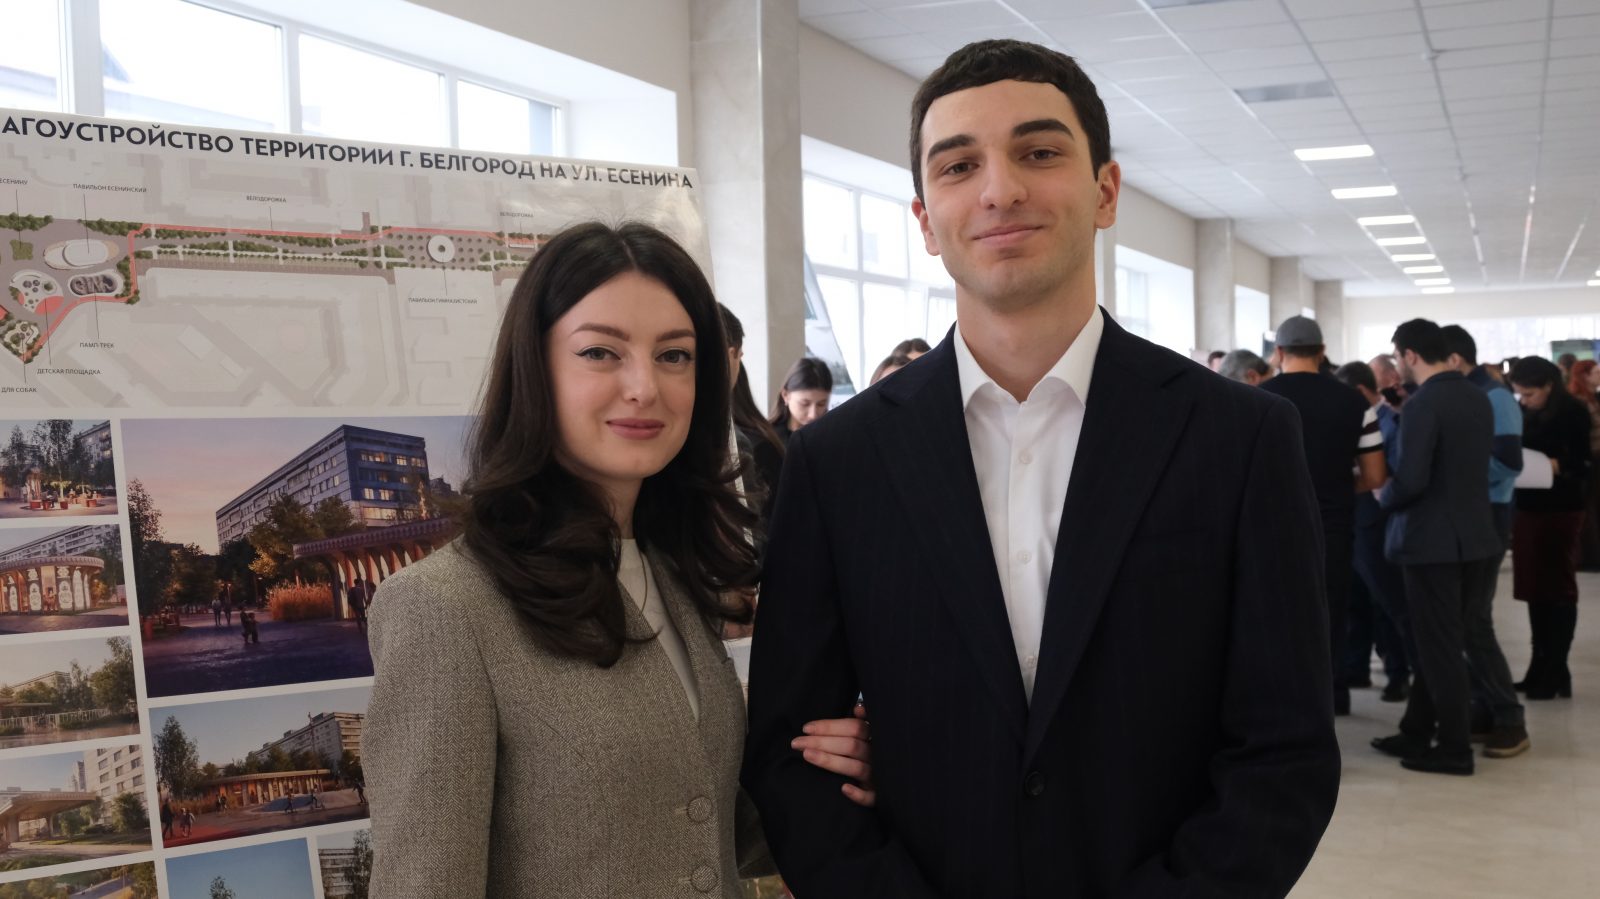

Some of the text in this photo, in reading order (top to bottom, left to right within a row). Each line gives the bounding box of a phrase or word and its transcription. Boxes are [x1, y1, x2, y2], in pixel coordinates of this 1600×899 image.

[1, 115, 693, 189] АГОУСТРОЙСТВО ТЕРРИТОРИИ Г. БЕЛГОРОД НА УЛ. ЕСЕНИНА
[73, 183, 107, 191] ПАВИЛЬОН
